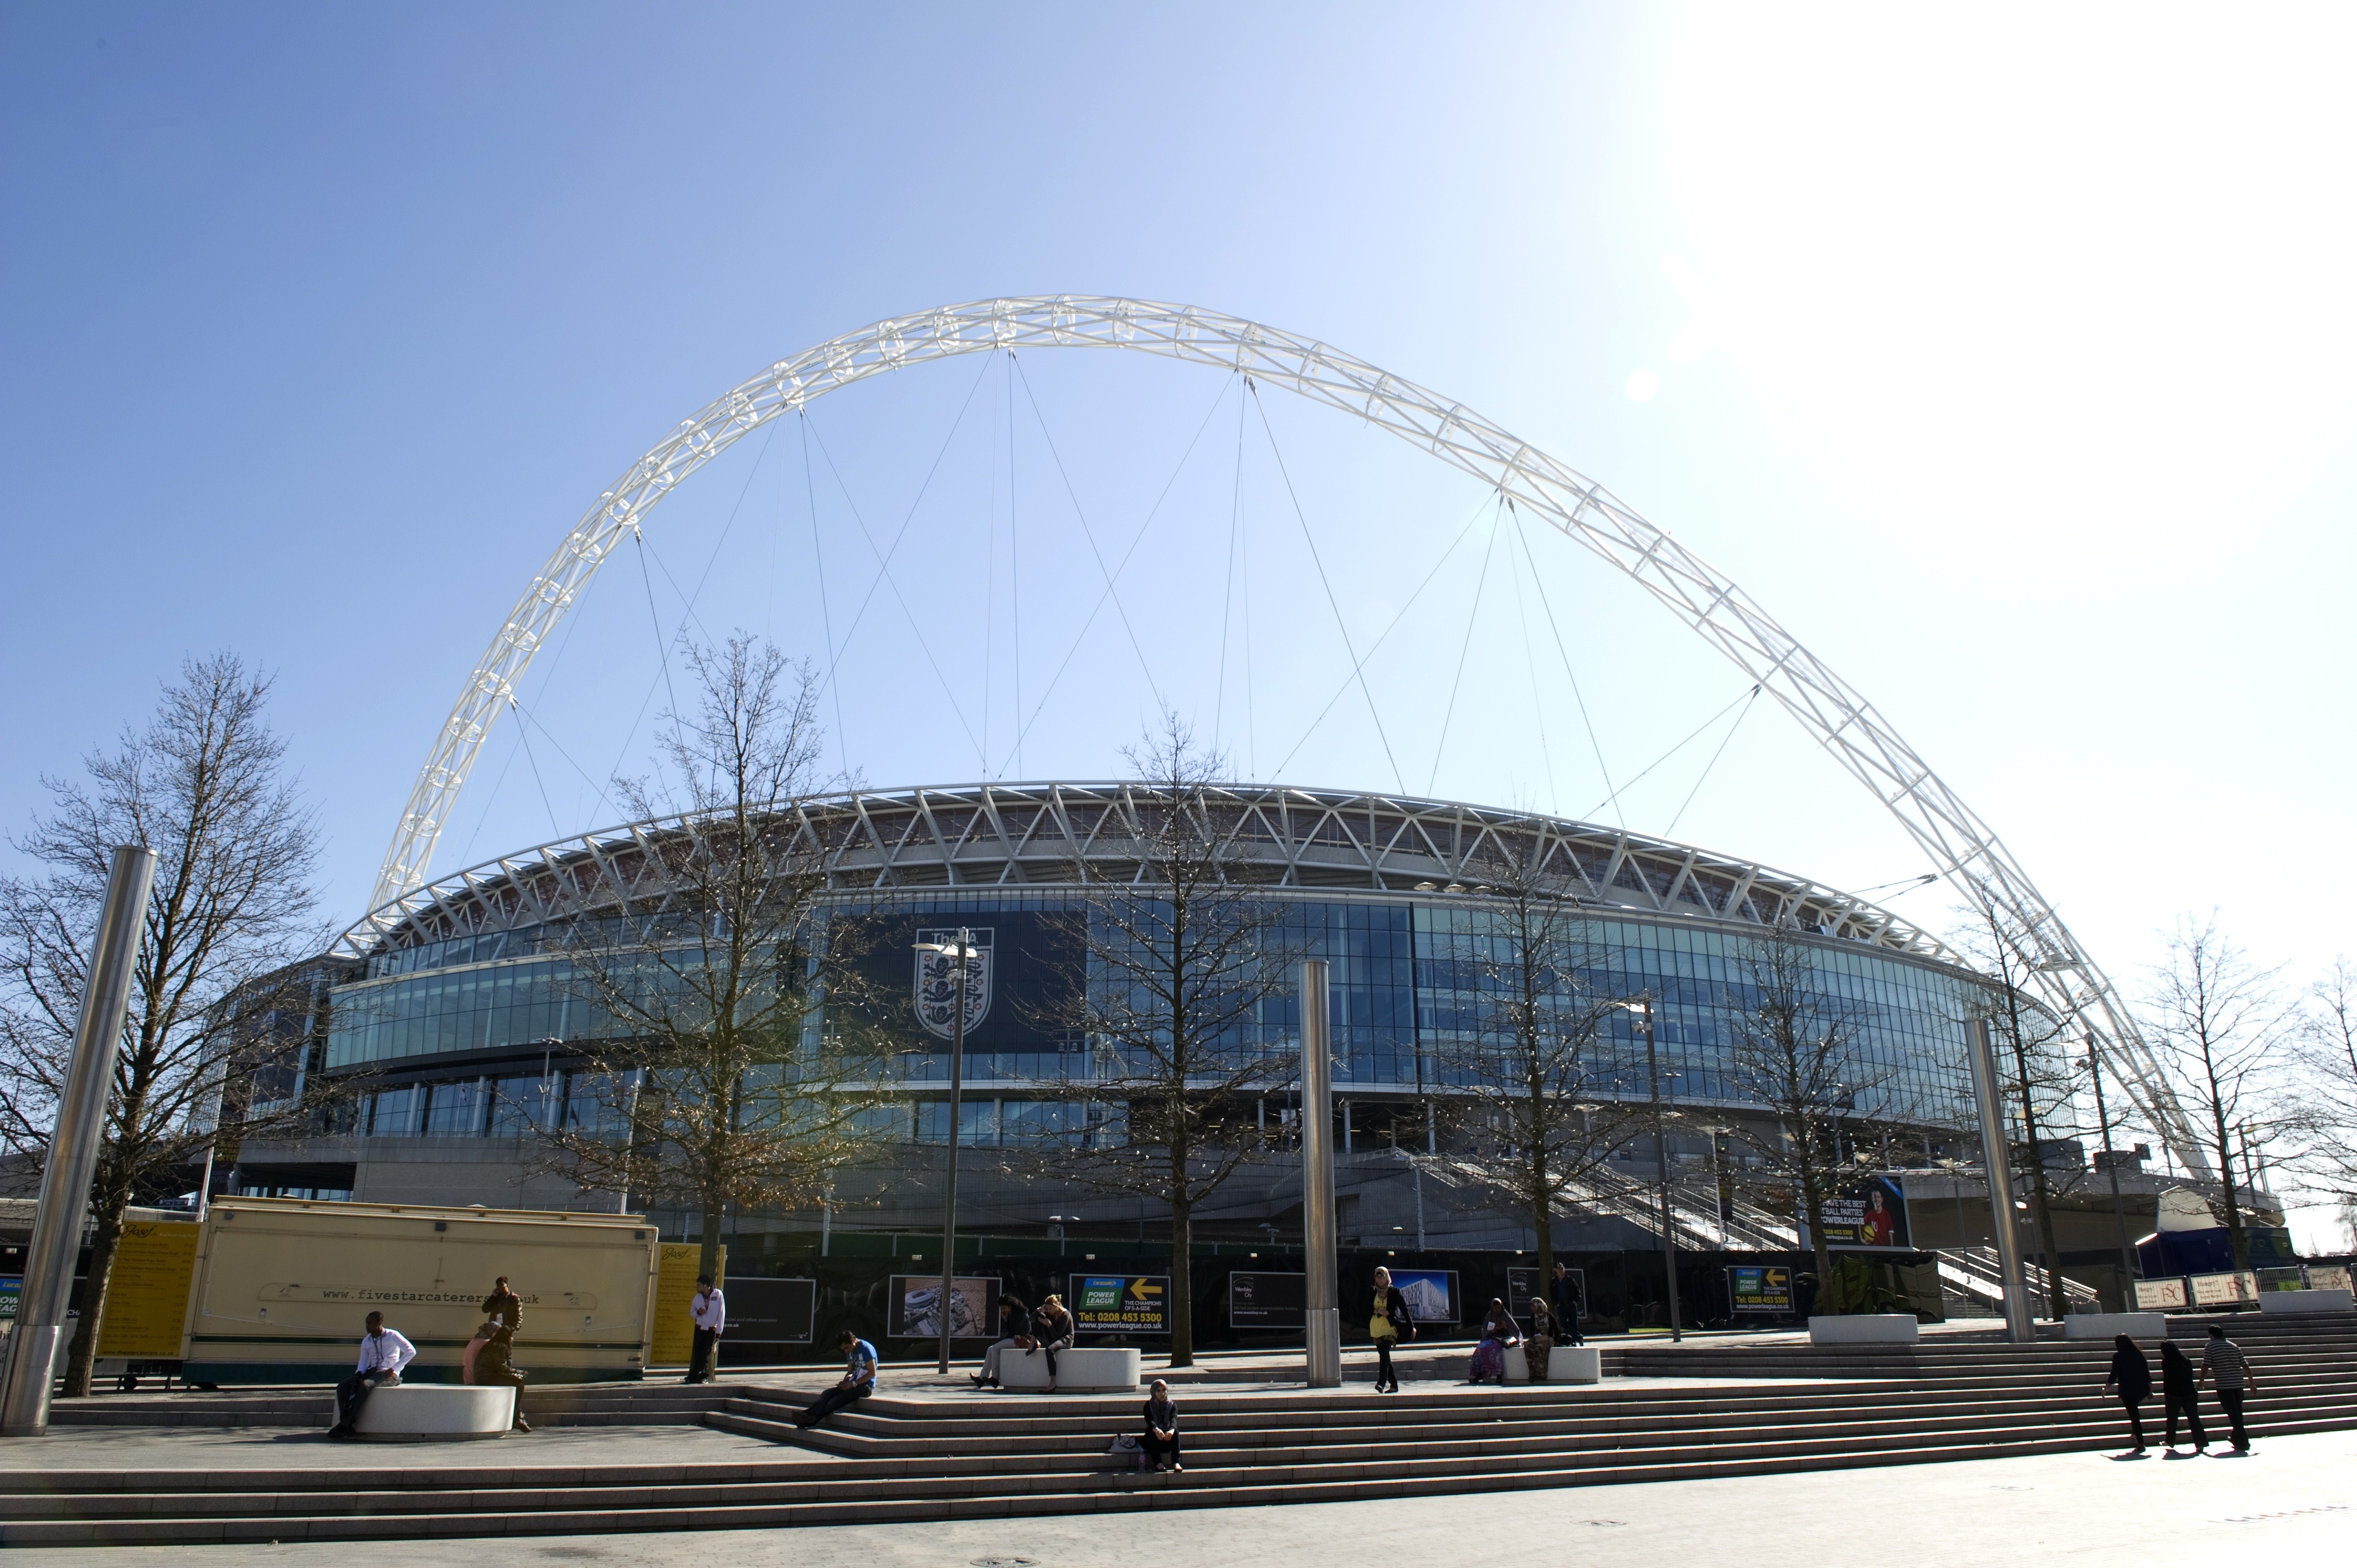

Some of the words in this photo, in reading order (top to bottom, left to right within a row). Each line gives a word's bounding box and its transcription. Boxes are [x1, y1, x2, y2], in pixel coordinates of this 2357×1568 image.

[1839, 1199, 1852, 1208] THE
[1840, 1208, 1863, 1216] PARTIES
[1821, 1216, 1865, 1225] OWERLEAGUE
[121, 1224, 158, 1239] Josef
[662, 1247, 691, 1260] Josef
[2227, 1277, 2253, 1296] FSC
[2160, 1283, 2181, 1302] FSC
[1078, 1312, 1096, 1322] Tel:
[1097, 1312, 1120, 1322] 0208
[1121, 1313, 1138, 1322] 453
[1140, 1313, 1162, 1322] 5300
[1078, 1322, 1162, 1330] www.powerleague.co.uk
